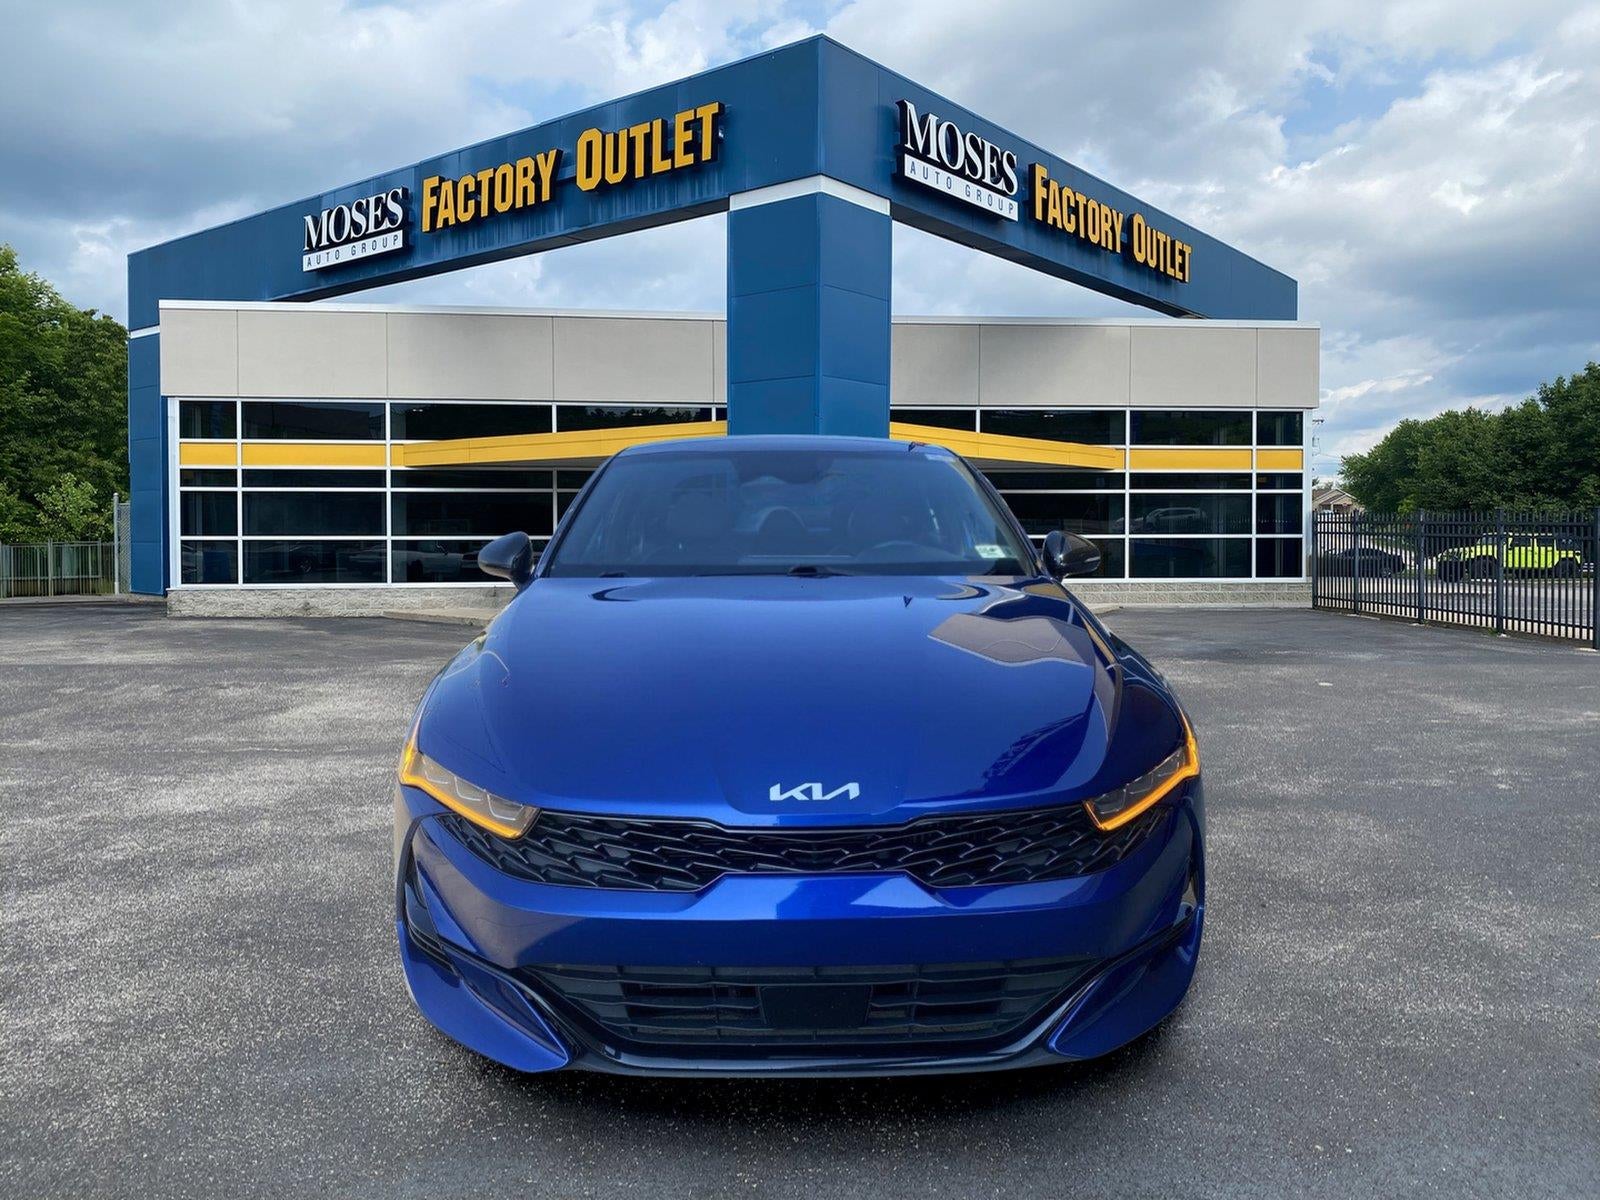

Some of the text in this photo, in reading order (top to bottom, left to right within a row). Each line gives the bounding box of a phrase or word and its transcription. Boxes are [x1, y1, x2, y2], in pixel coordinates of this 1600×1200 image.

[421, 101, 720, 233] FACTORY OUTLET
[904, 99, 1018, 196] MOSES
[303, 187, 403, 252] MOSES
[910, 161, 1014, 215] AUTO GROUP
[306, 234, 400, 268] AUTO GROUP
[1034, 163, 1192, 283] FACTORY OUTLET
[769, 782, 861, 801] KIA
